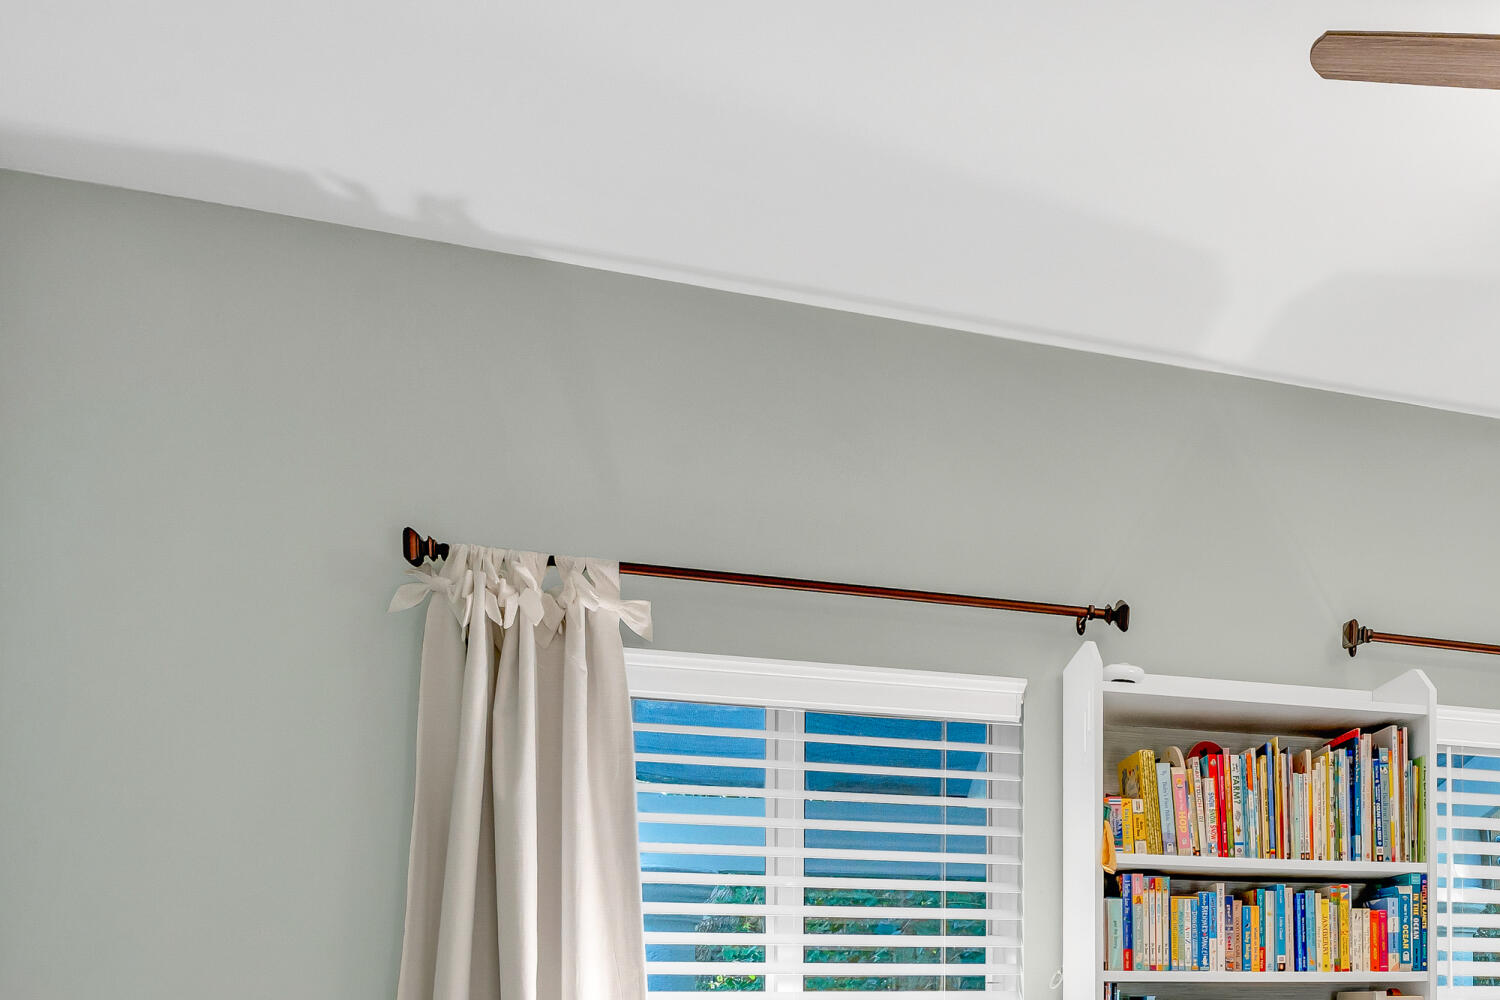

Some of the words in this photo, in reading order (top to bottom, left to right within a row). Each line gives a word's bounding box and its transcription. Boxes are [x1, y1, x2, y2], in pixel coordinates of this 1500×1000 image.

[1232, 775, 1241, 804] FARM?
[1413, 893, 1419, 901] IN
[1201, 905, 1209, 933] BARNYARD
[1402, 924, 1410, 949] OCEAN
